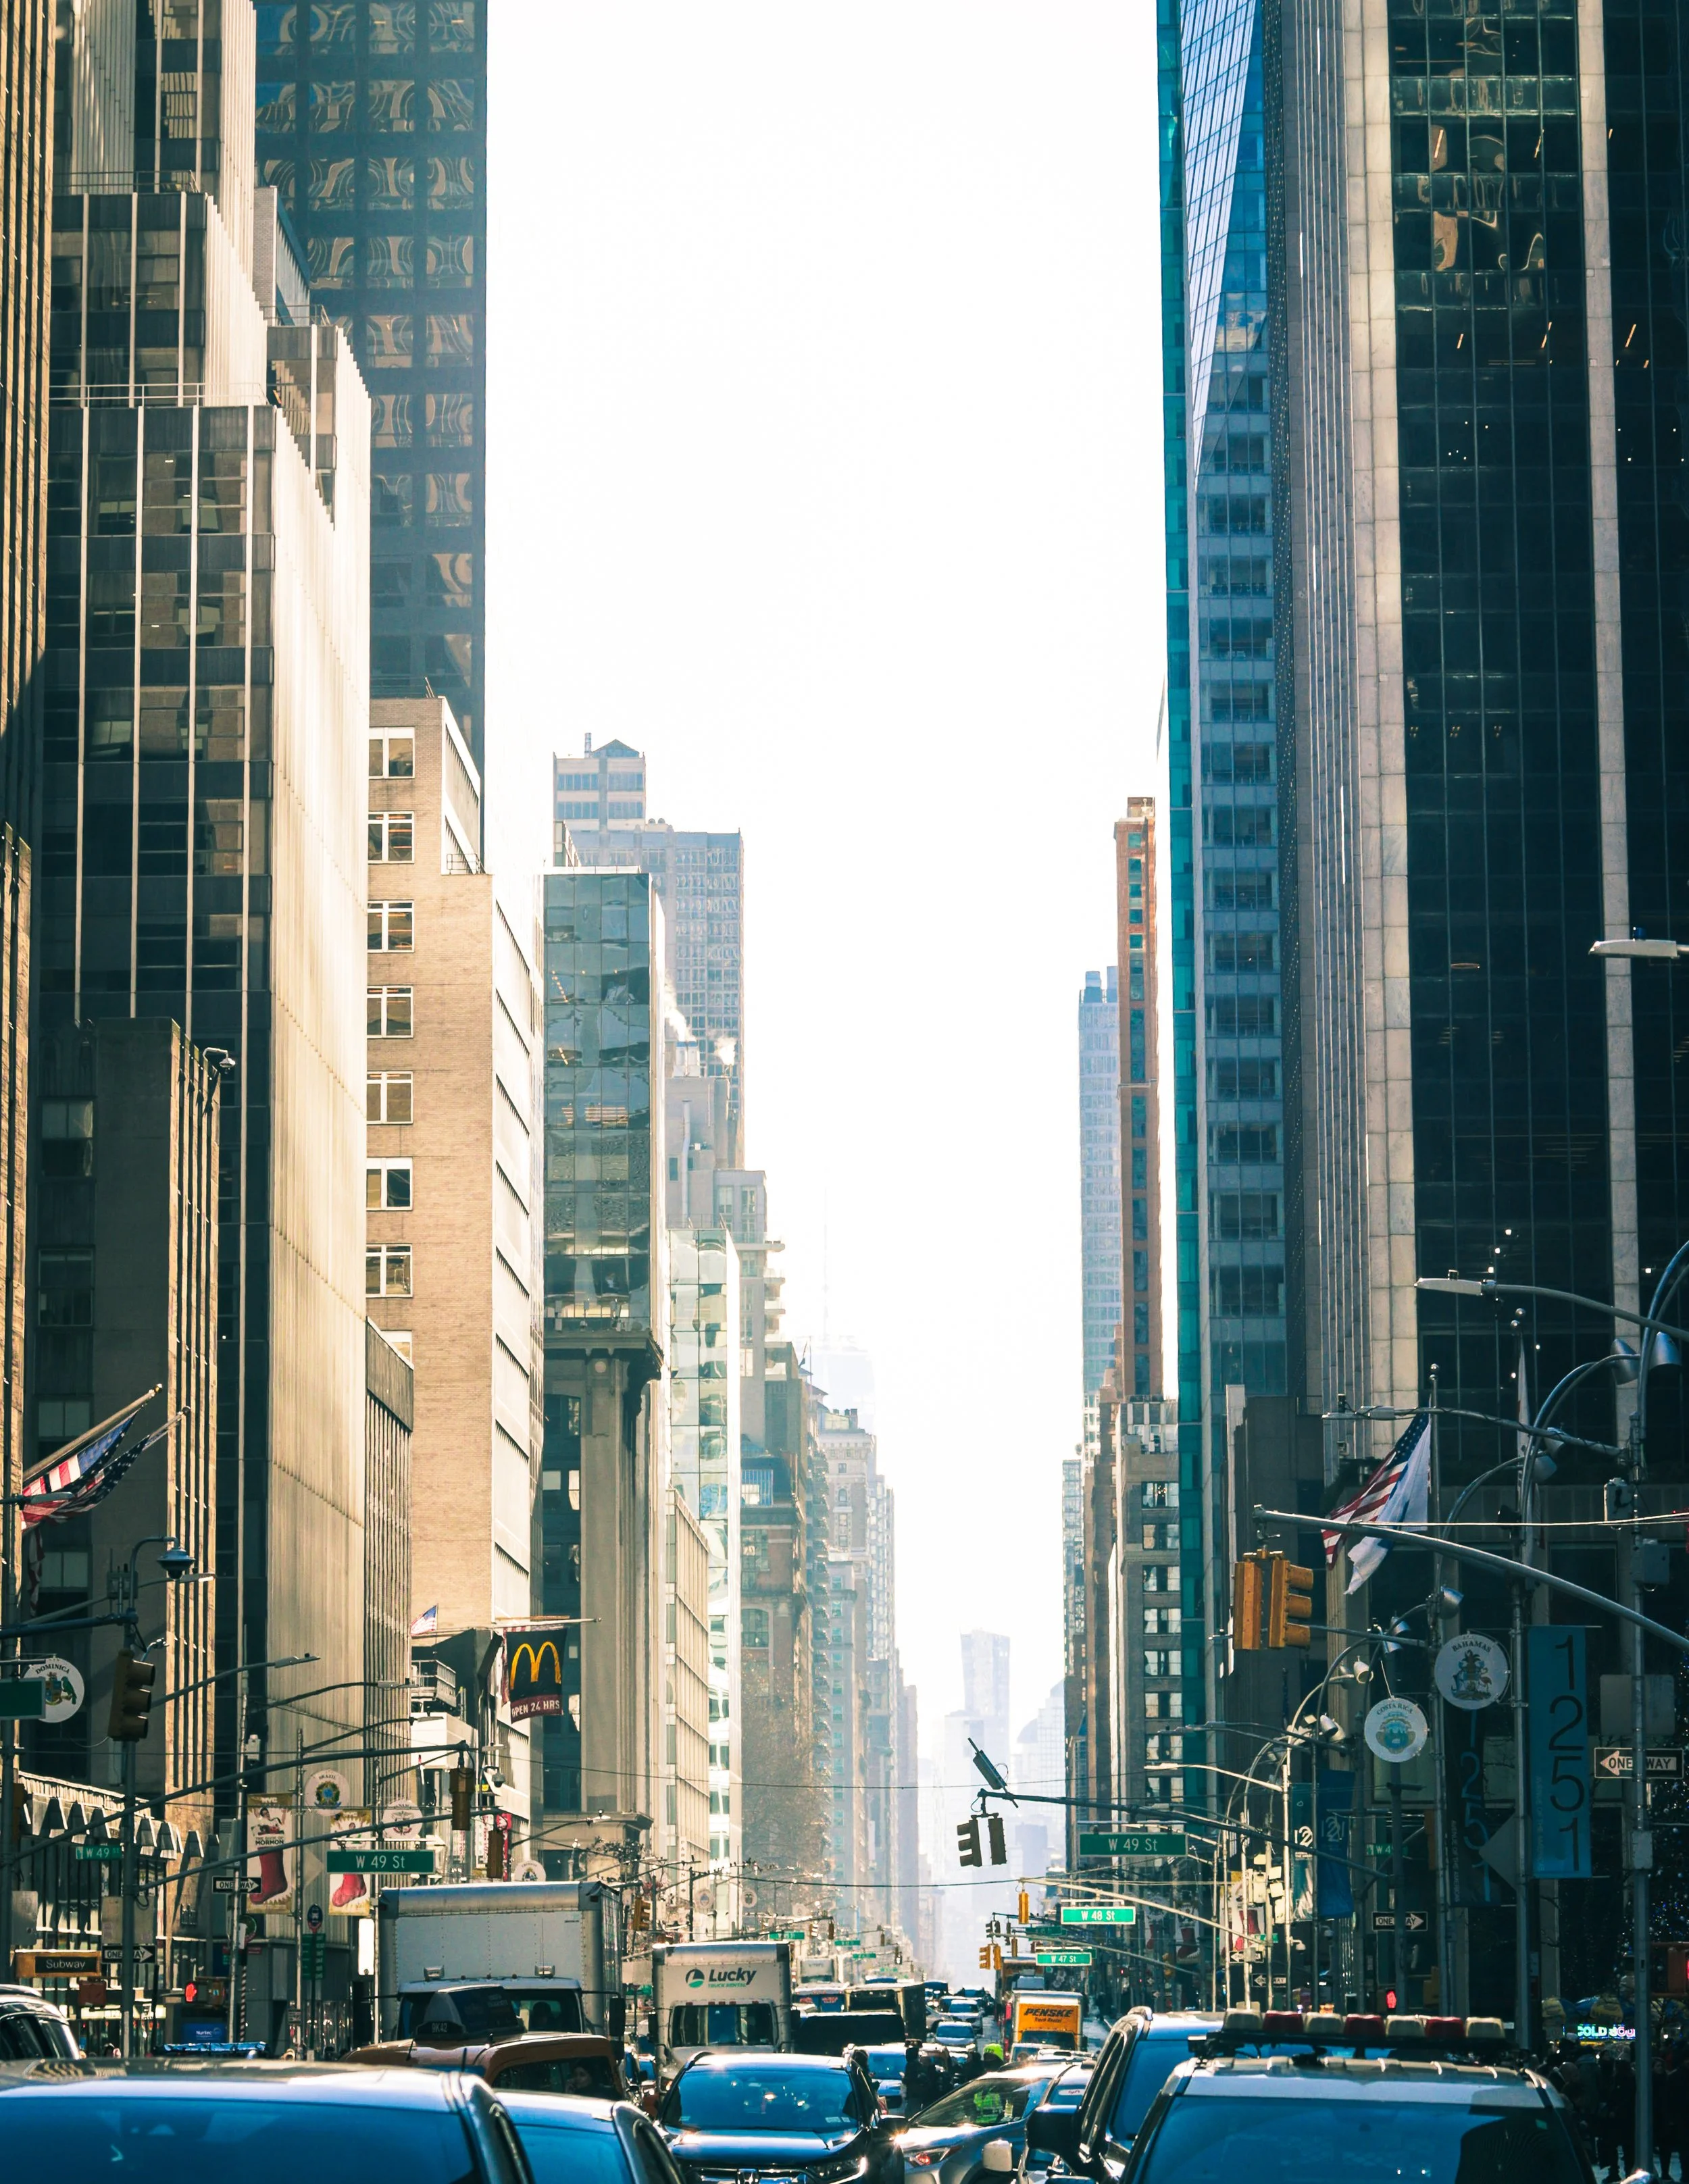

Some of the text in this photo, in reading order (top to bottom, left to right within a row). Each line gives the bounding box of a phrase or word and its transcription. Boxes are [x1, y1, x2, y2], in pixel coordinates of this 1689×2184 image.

[1452, 1640, 1492, 1653] BAHAMAS
[36, 1664, 70, 1674] DOMINICA
[511, 1700, 560, 1717] OPEN 24 HRS
[1376, 1703, 1413, 1715] COSTA RICA
[1548, 1634, 1585, 1872] 1251
[1609, 1757, 1671, 1769] ONE WAY
[1109, 1839, 1157, 1852] W 49 St
[86, 1848, 93, 1857] W
[96, 1848, 109, 1857] 49
[356, 1856, 405, 1869] W 49 St
[1081, 1911, 1115, 1921] W 48 St
[46, 1960, 85, 1969] Subway
[709, 1967, 757, 1985] Lucky
[1024, 2008, 1074, 2017] PENSKE
[1578, 2026, 1607, 2037] COLD
